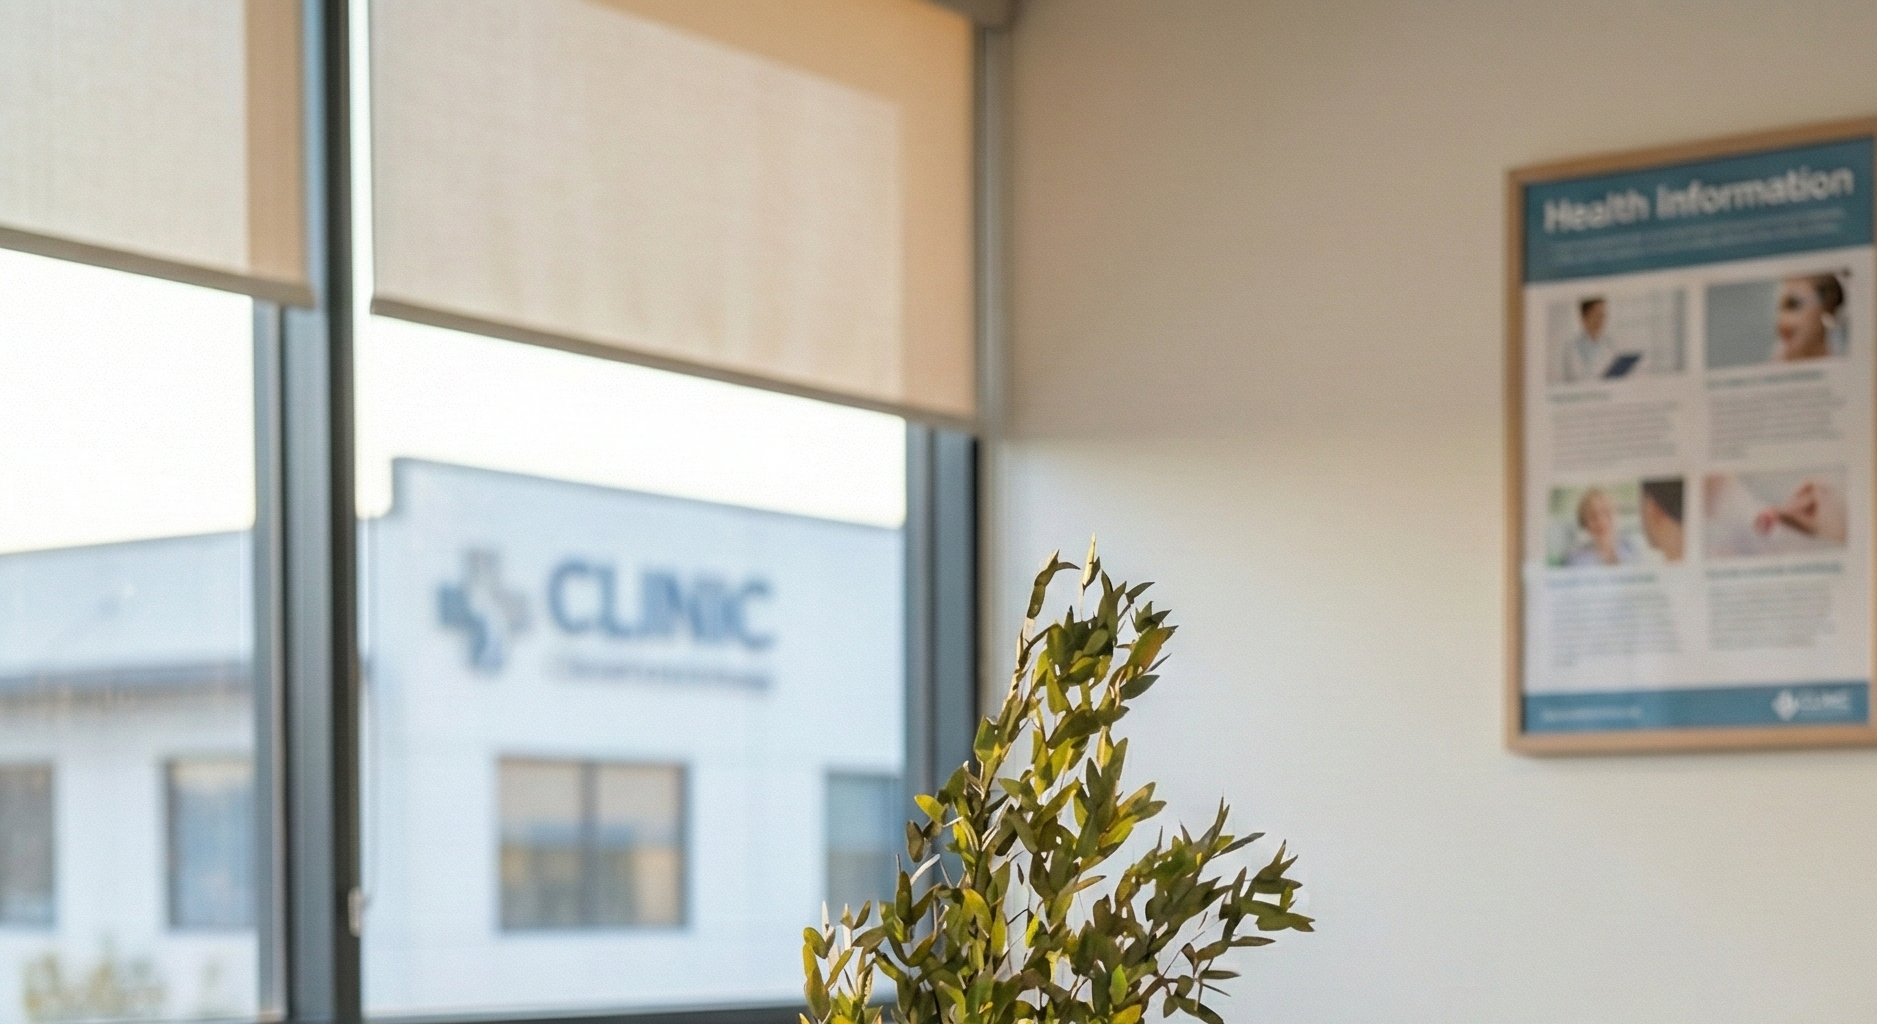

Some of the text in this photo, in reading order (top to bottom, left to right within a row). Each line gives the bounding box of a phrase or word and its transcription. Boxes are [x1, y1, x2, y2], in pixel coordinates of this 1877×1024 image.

[1543, 164, 1855, 234] Health Information
[547, 555, 775, 650] CLINIC
